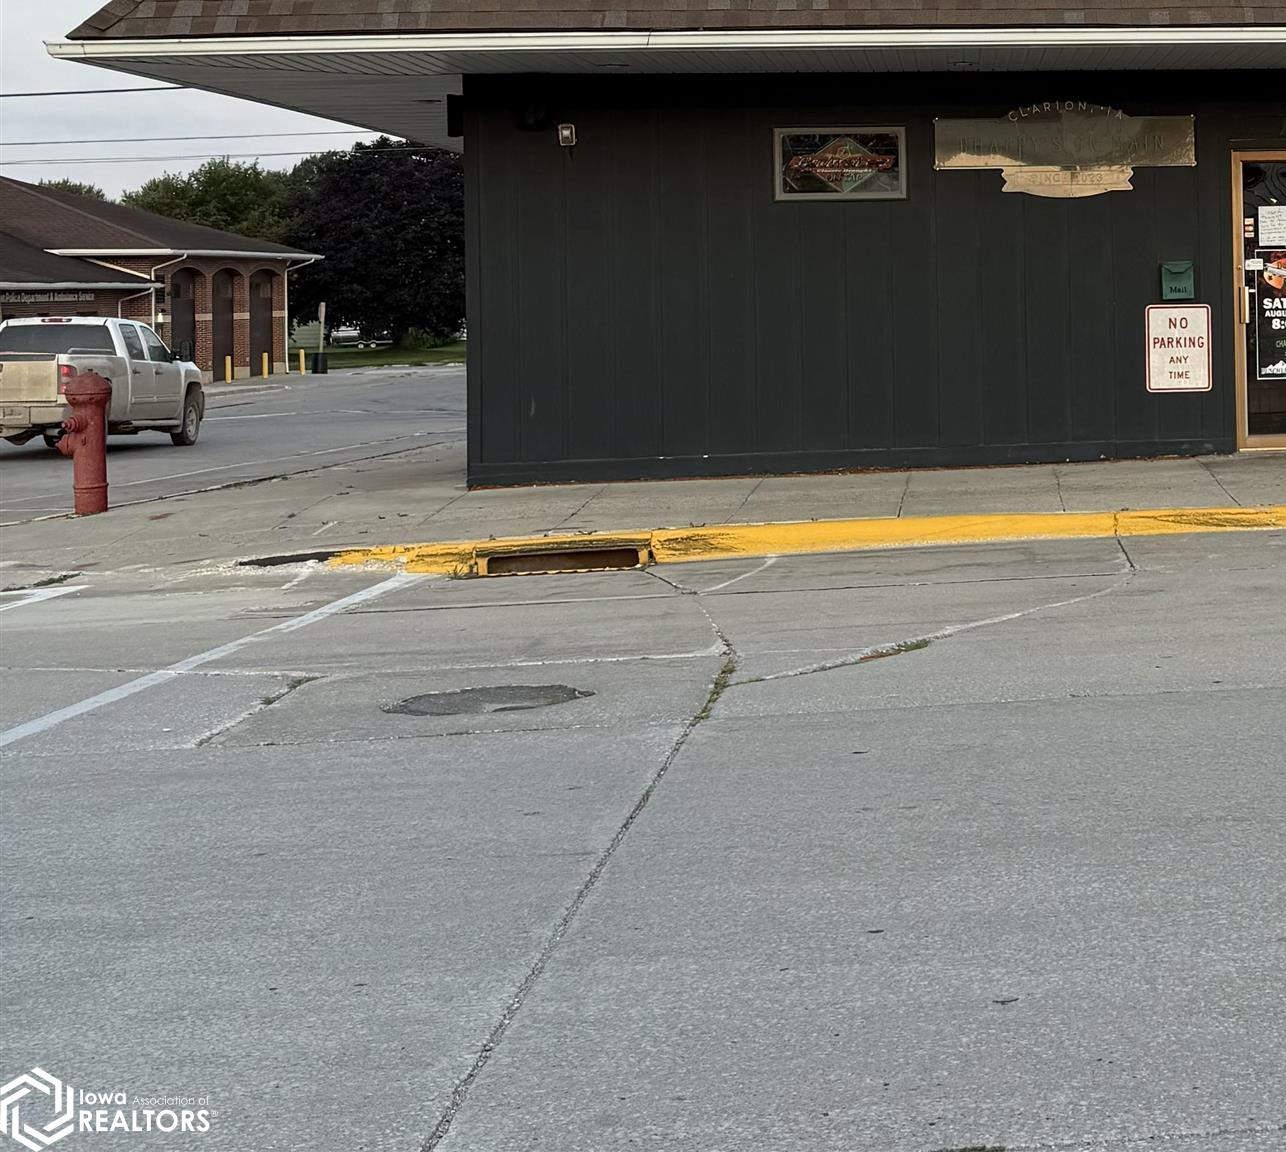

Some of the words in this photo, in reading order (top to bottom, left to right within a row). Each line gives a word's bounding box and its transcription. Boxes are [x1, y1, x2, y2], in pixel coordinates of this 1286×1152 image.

[1106, 105, 1124, 120] IA
[1168, 317, 1189, 330] NO
[1153, 336, 1205, 349] PARKING
[1169, 356, 1190, 365] ANY
[1168, 371, 1191, 380] TIME
